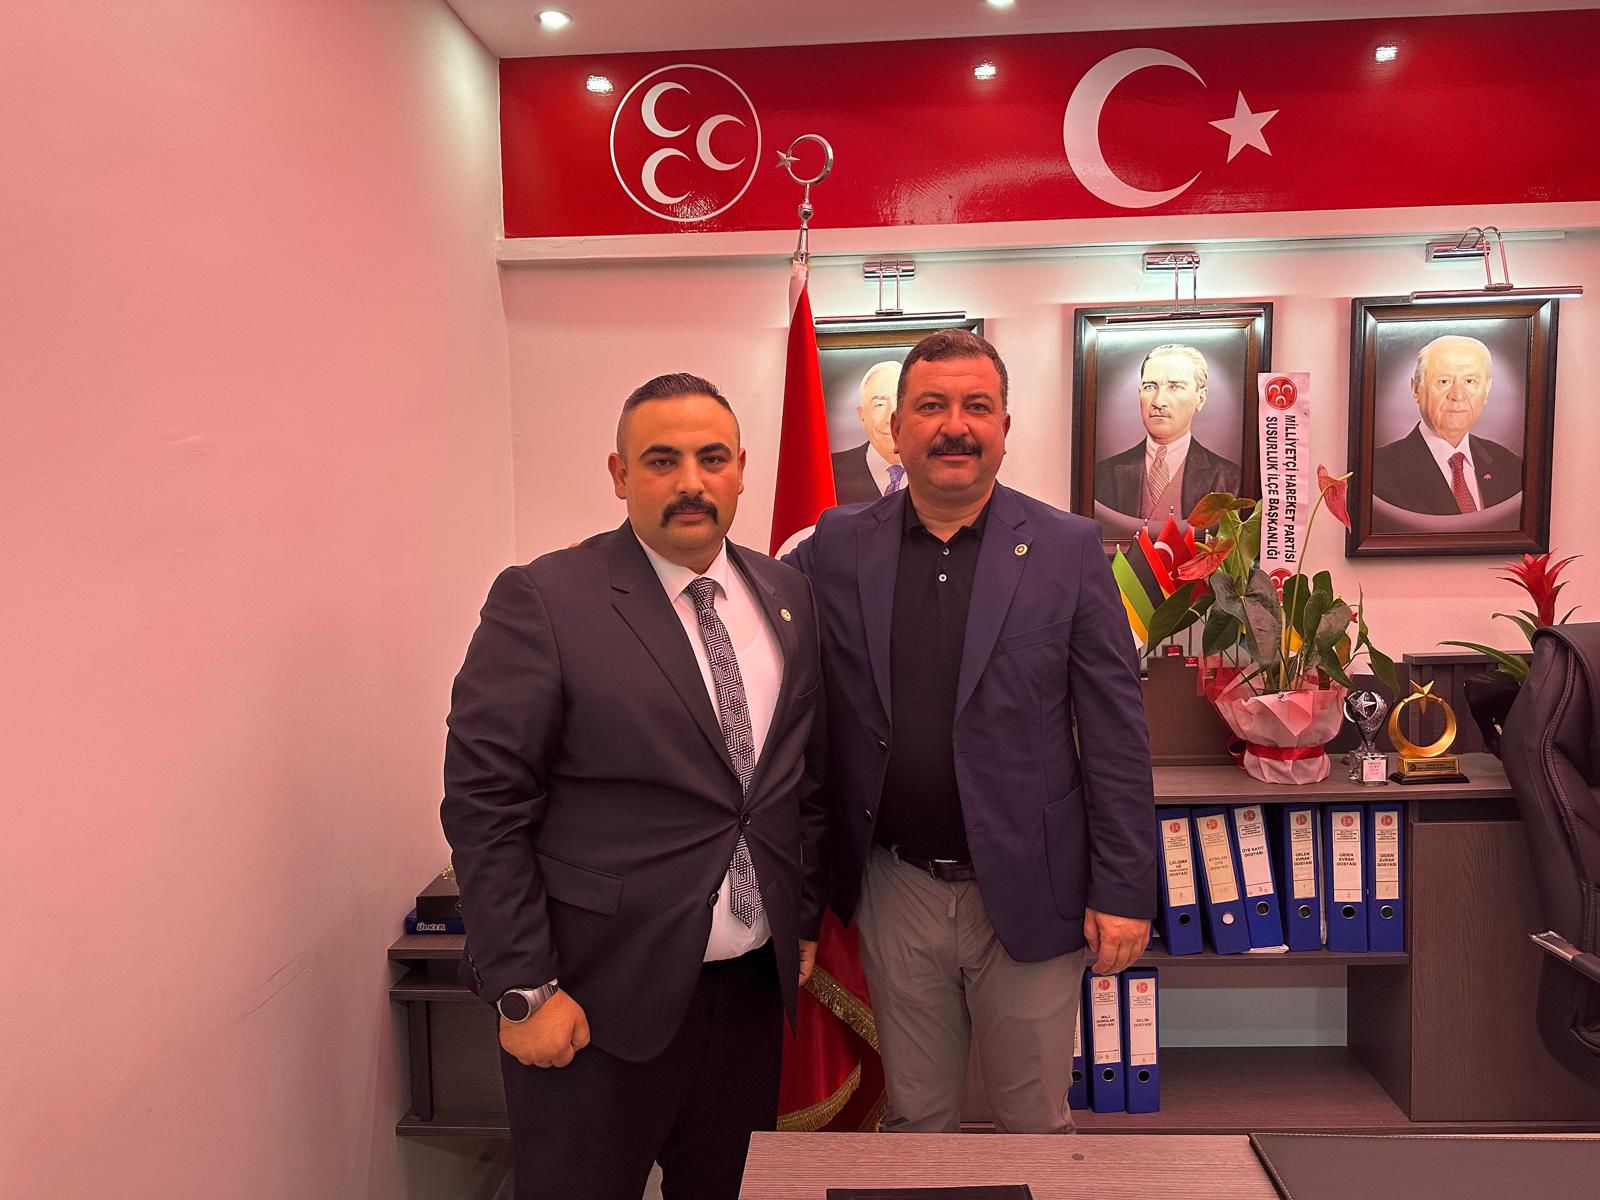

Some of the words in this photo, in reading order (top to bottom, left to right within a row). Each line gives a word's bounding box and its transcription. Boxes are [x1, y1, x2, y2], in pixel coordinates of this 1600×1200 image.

[1265, 416, 1278, 471] SUSURLUK
[1284, 414, 1299, 472] MİLLİYETÇİ
[1265, 473, 1279, 496] İLÇE
[1284, 475, 1297, 522] HAREKET
[1265, 498, 1281, 560] BAŞKANLIĞI
[1284, 524, 1297, 563] PARTİSİ
